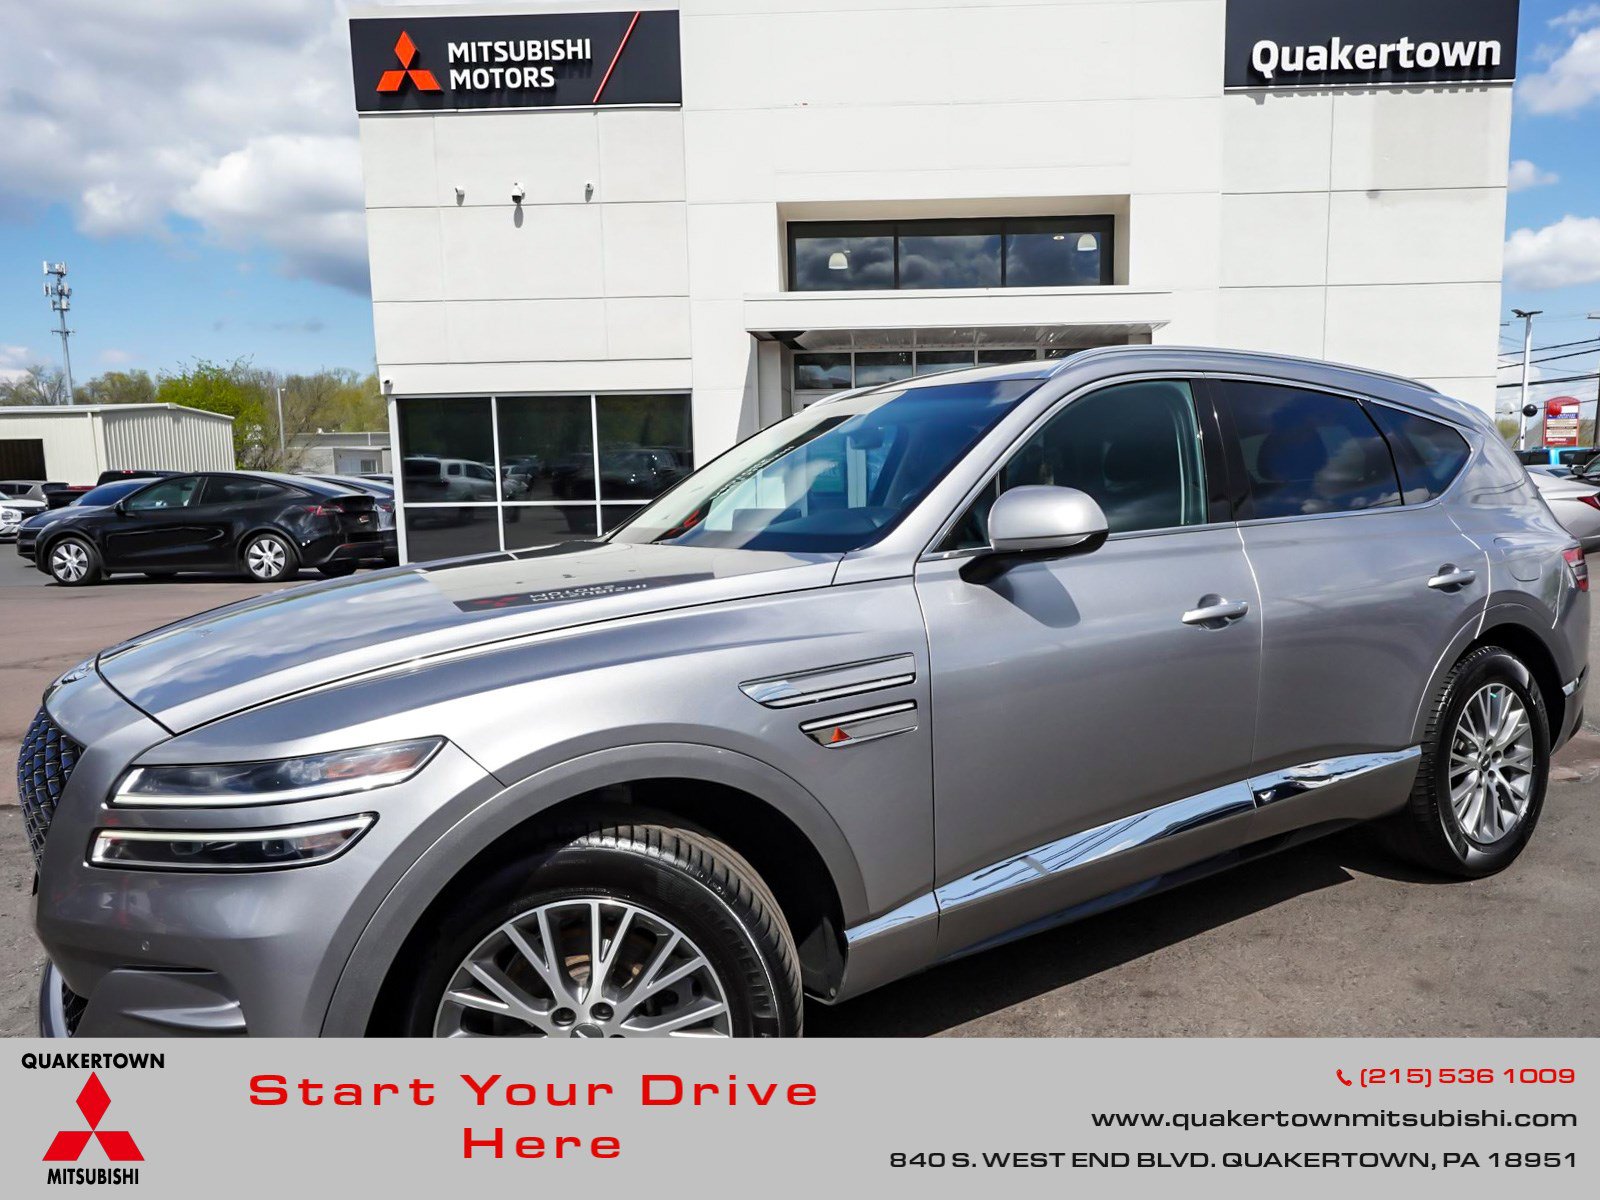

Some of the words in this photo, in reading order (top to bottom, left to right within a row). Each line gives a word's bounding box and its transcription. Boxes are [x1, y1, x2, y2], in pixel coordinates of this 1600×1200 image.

[448, 38, 592, 63] MITSUBISHI
[1252, 36, 1502, 80] Quakertown
[450, 66, 556, 91] MOTORS
